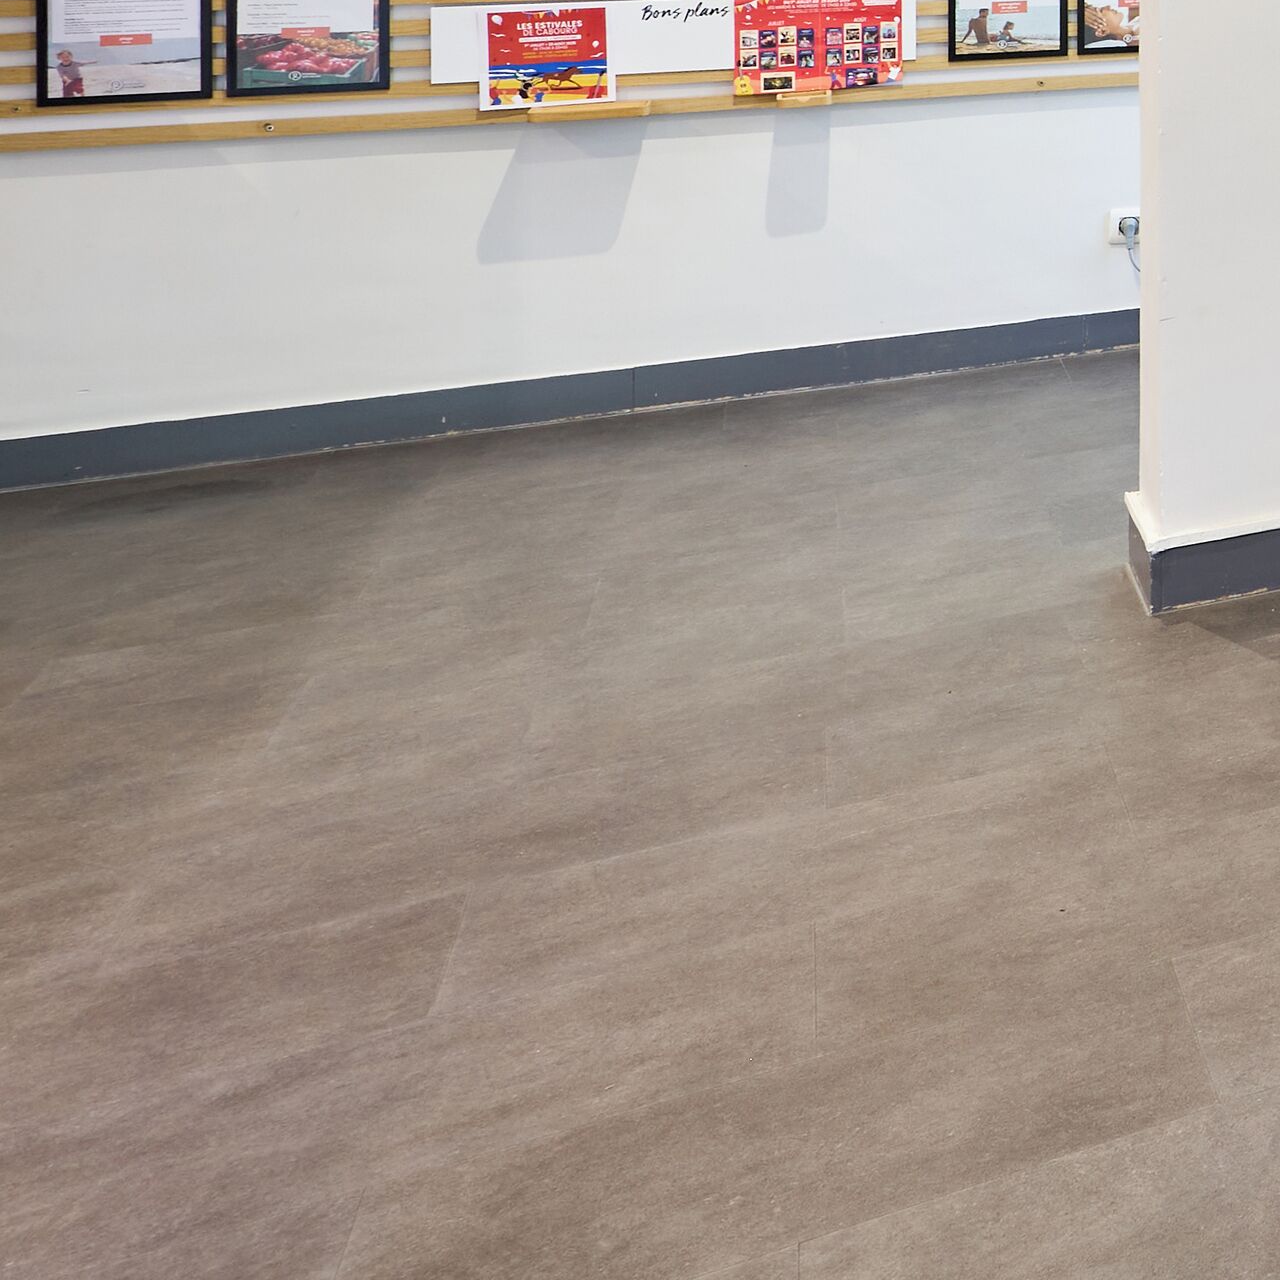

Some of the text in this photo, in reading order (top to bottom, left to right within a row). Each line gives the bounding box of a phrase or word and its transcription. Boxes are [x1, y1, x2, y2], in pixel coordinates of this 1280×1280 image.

[642, 1, 729, 23] Bons plans
[517, 20, 583, 30] LES ESTIVALES
[535, 27, 578, 36] CABOURG
